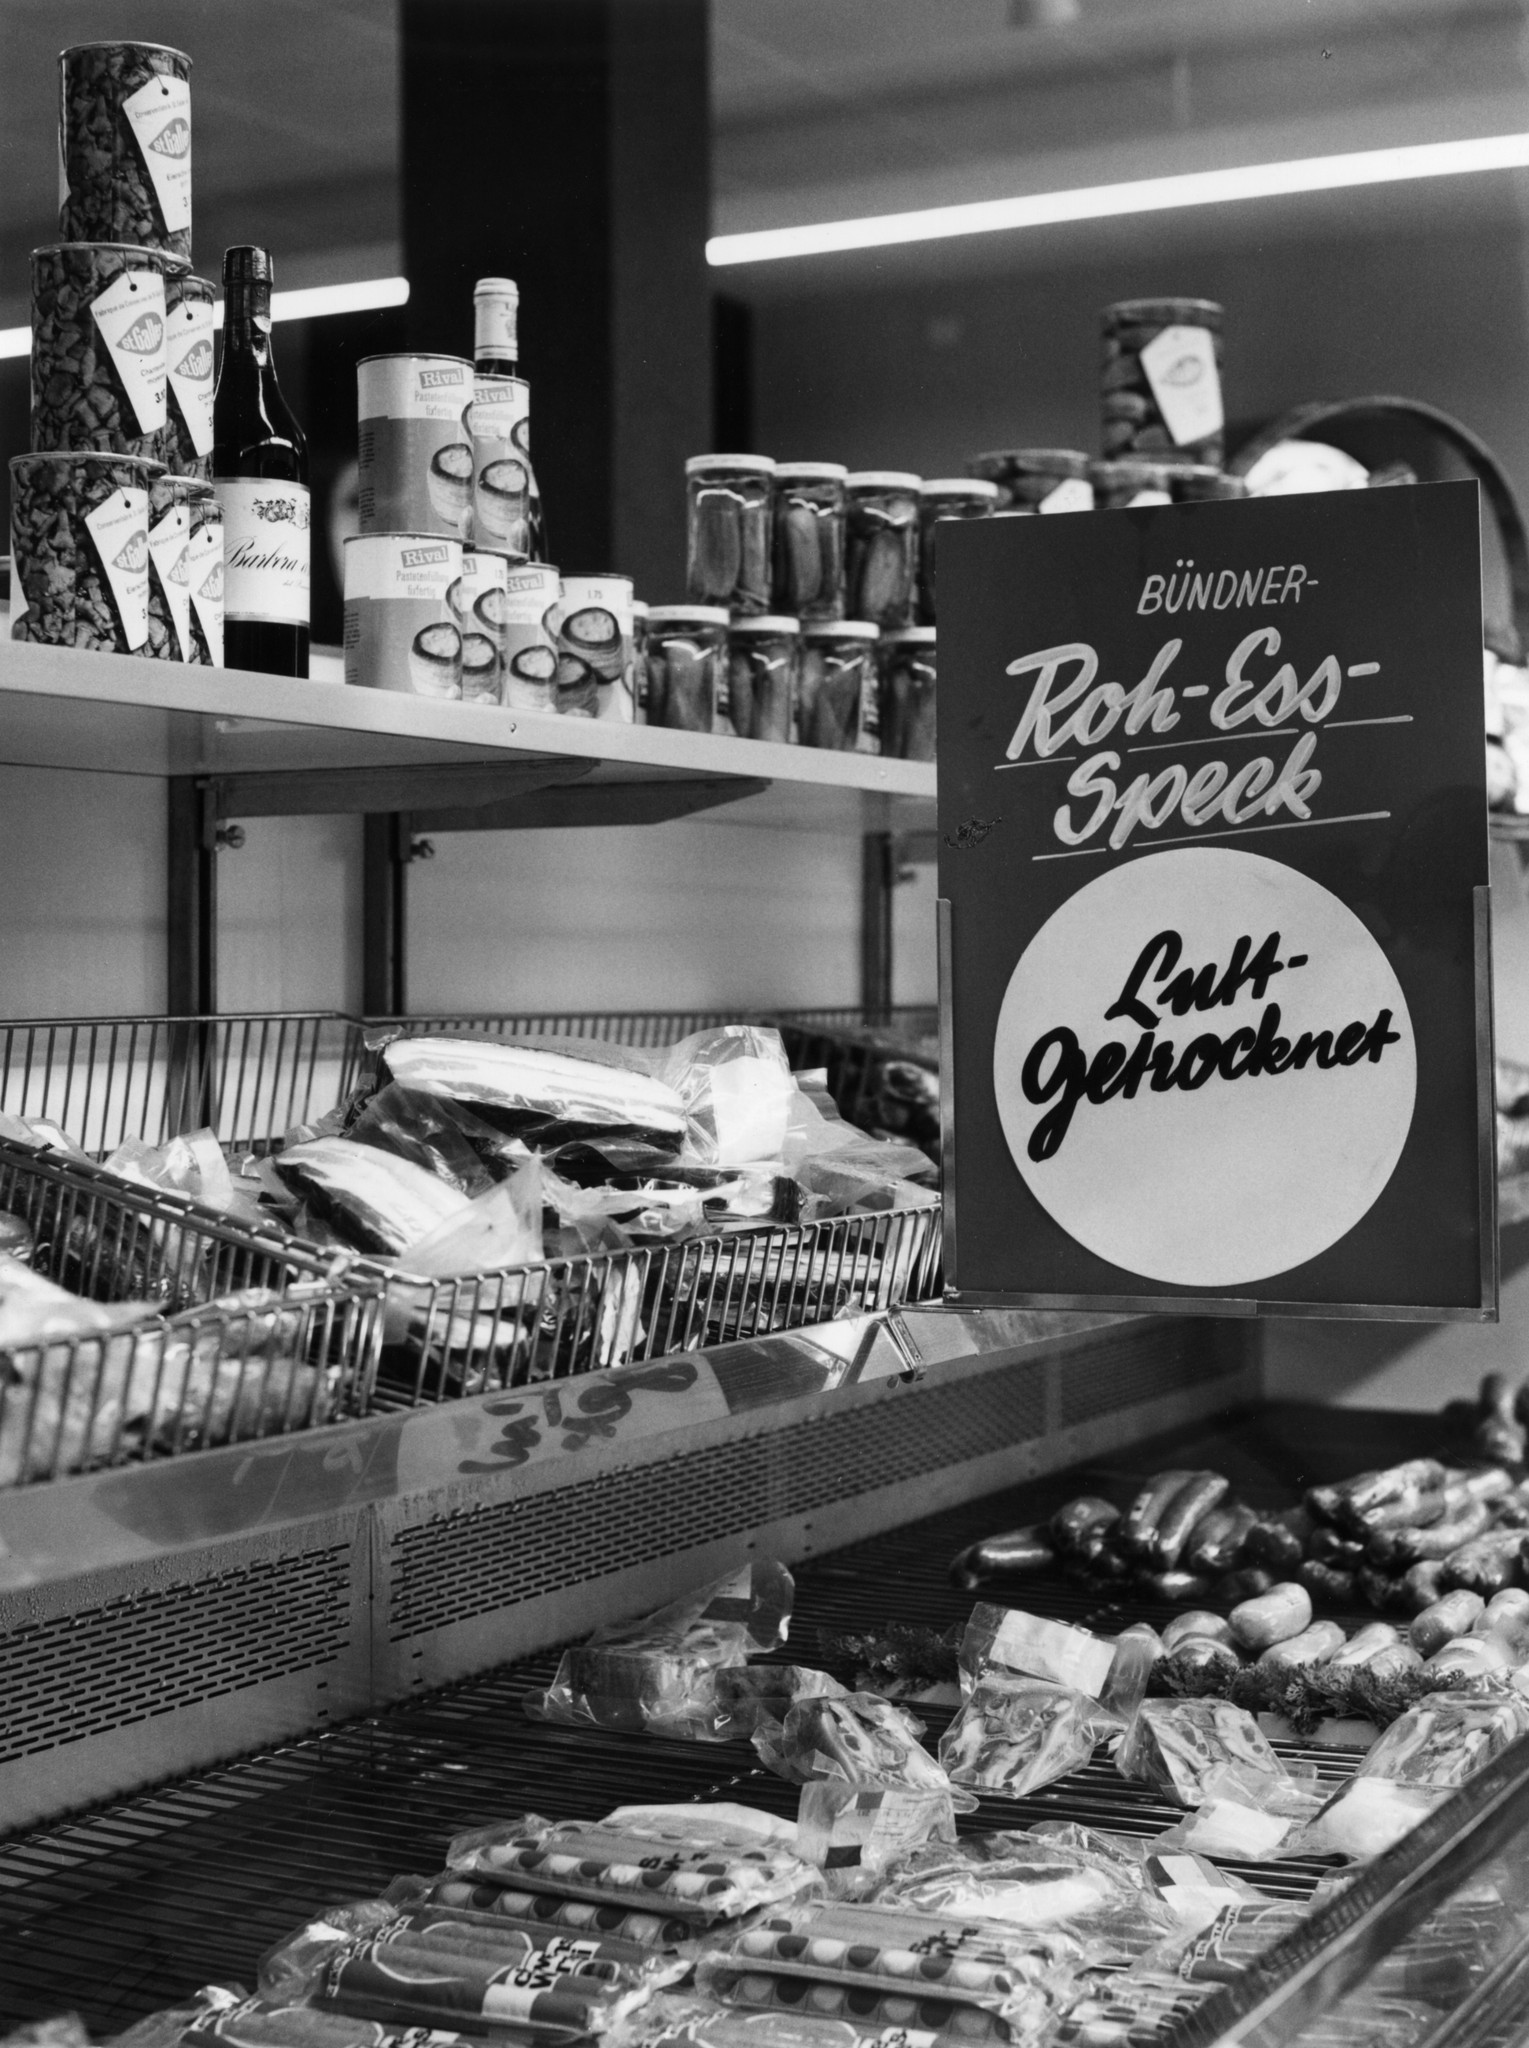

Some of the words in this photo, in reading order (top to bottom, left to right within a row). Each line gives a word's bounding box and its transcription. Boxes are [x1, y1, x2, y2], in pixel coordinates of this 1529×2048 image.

[421, 368, 463, 387] Rival
[474, 386, 514, 405] Rival
[222, 535, 299, 570] Barbera
[403, 545, 449, 566] Rival
[507, 574, 544, 592] Rival
[1136, 558, 1319, 616] BÜNDNER-
[1005, 626, 1381, 761] Roh-Ess-
[1053, 731, 1324, 850] Speck
[1103, 929, 1309, 1030] Luft-
